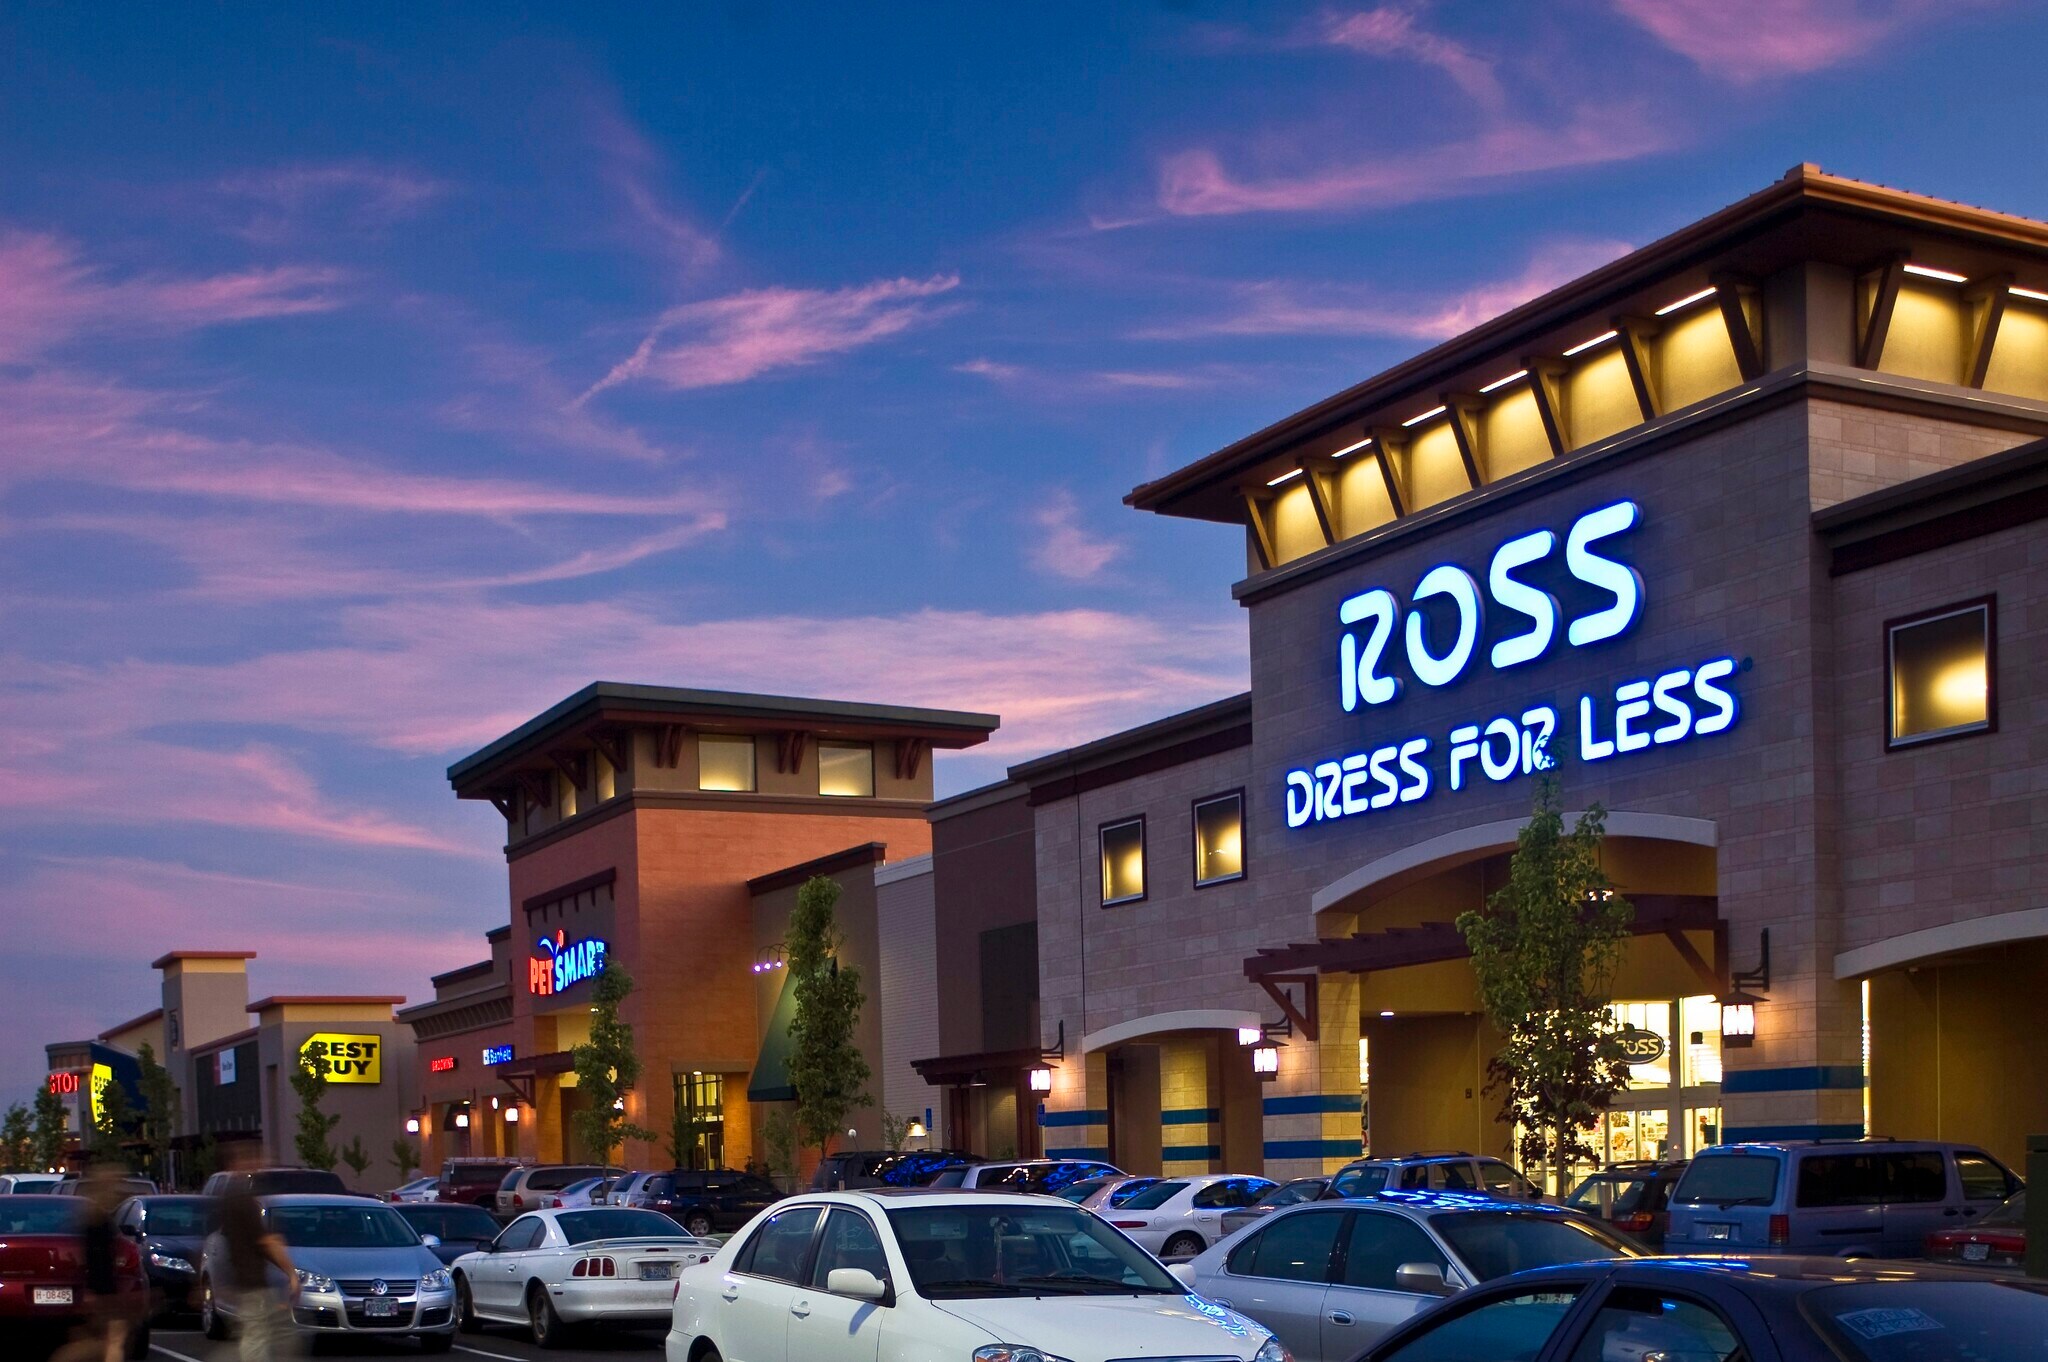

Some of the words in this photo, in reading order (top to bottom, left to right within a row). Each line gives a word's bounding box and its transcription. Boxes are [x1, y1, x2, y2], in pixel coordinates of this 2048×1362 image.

[1340, 501, 1640, 711] ROSS
[1286, 738, 1429, 828] DRESS
[1450, 706, 1556, 791] FOR
[1580, 659, 1736, 761] LESS
